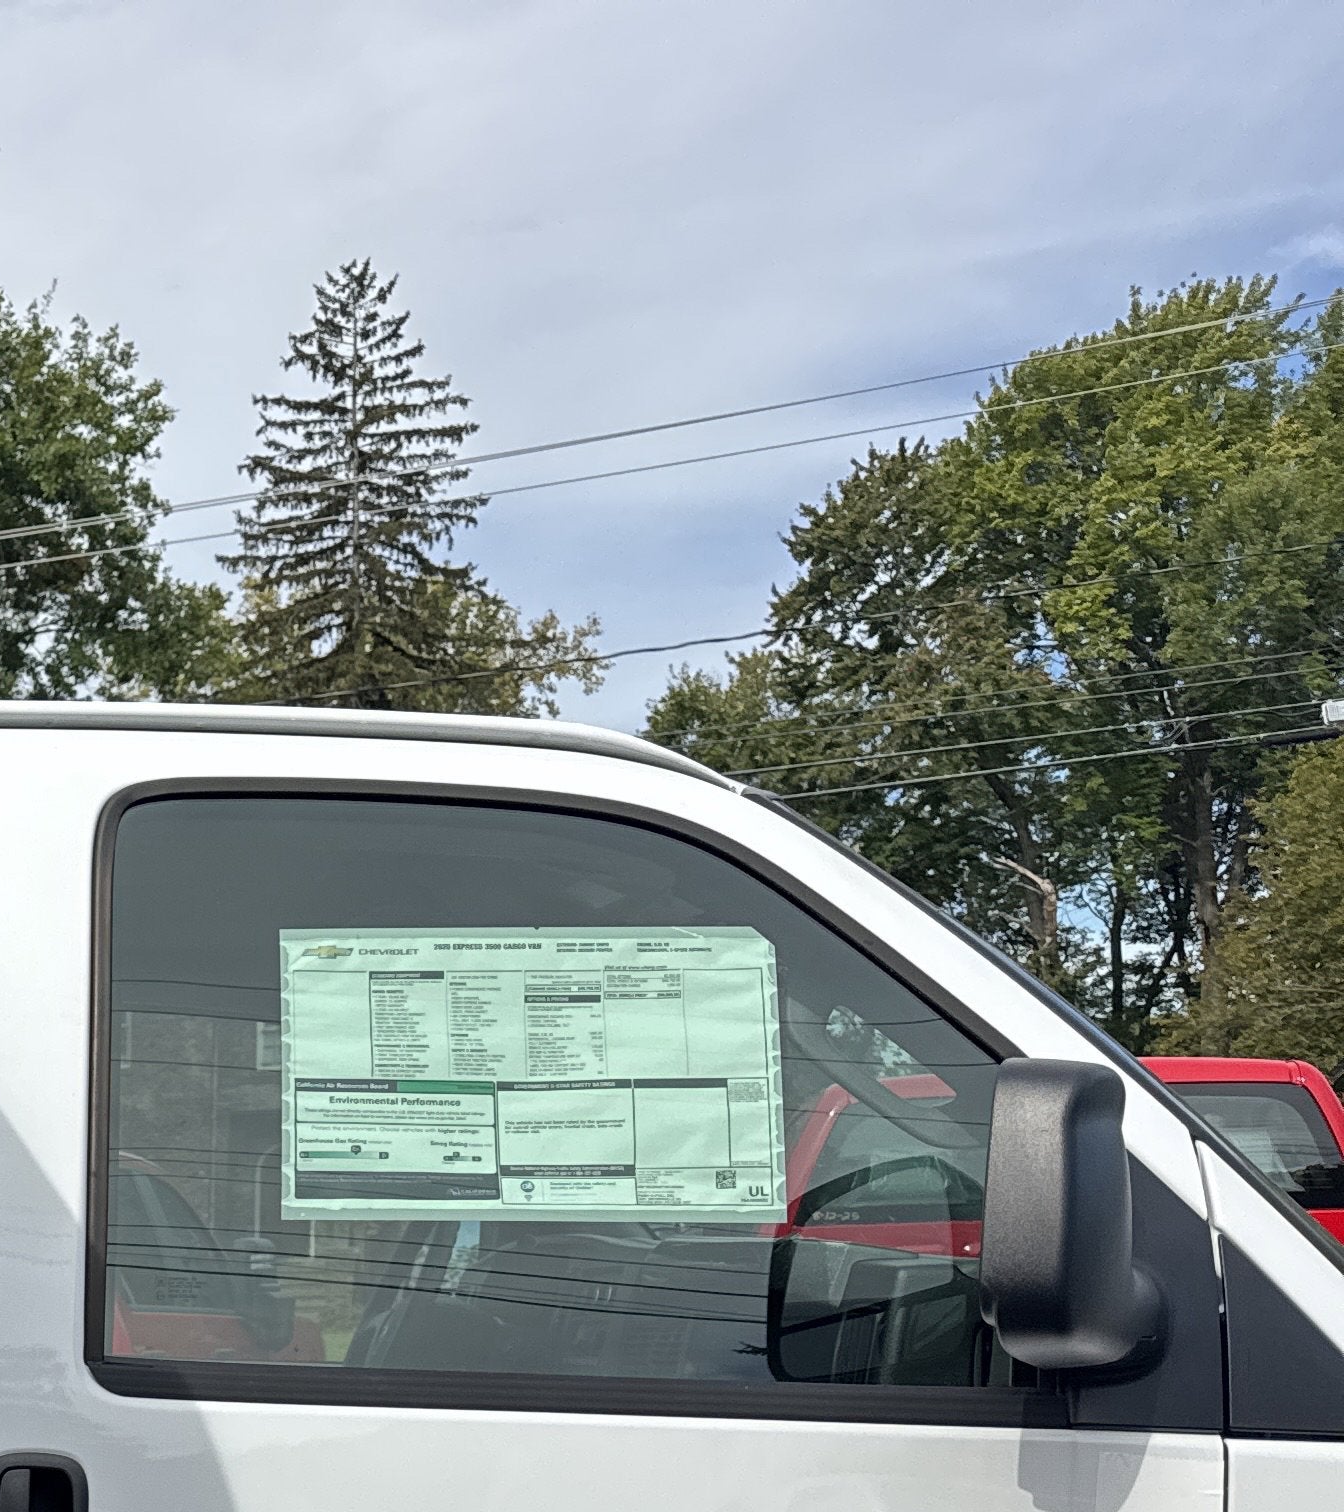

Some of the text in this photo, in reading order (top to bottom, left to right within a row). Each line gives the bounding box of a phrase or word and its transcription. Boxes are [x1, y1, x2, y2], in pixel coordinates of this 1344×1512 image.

[358, 948, 419, 956] CHEVROLET
[329, 1095, 461, 1107] Environmental Performance
[749, 1186, 769, 1197] UL
